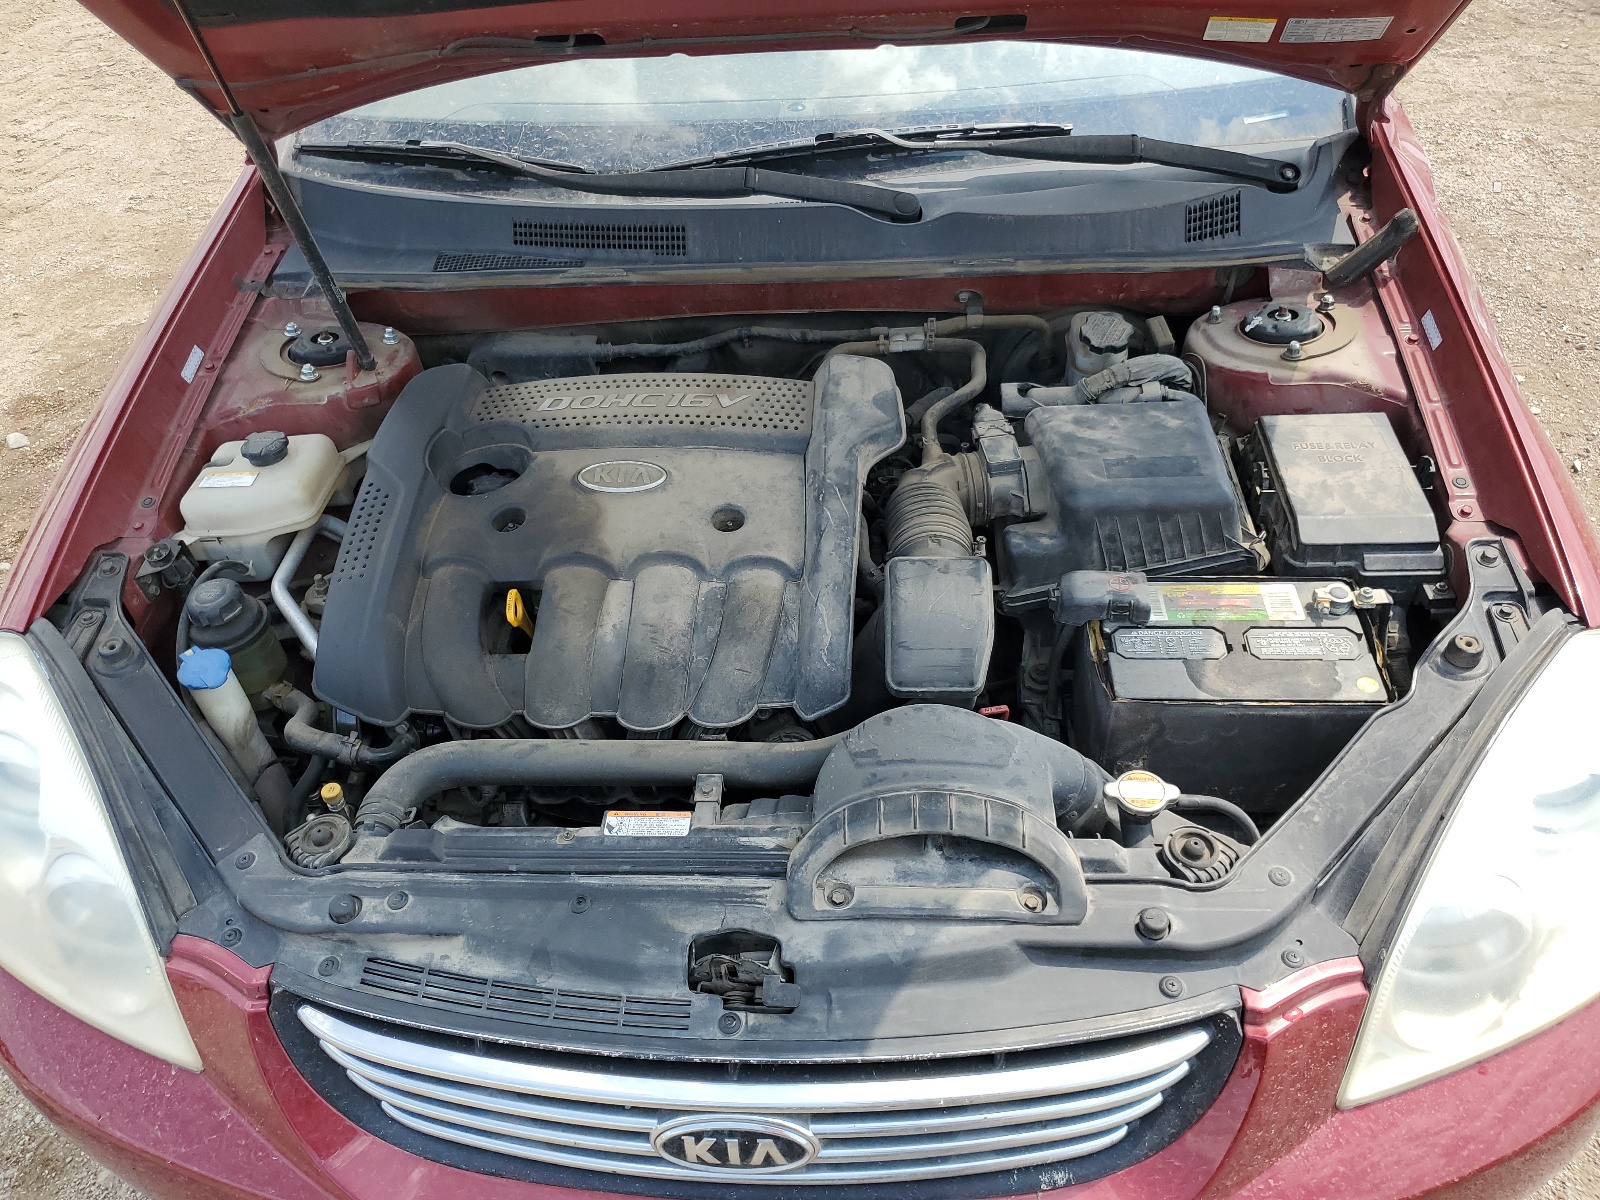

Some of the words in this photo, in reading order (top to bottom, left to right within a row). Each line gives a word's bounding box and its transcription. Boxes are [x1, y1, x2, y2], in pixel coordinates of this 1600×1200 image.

[537, 393, 665, 411] DOHC
[666, 393, 751, 408] 16V
[1318, 454, 1363, 463] BLOCK
[593, 466, 651, 484] KIA
[681, 1135, 789, 1166] KIA
